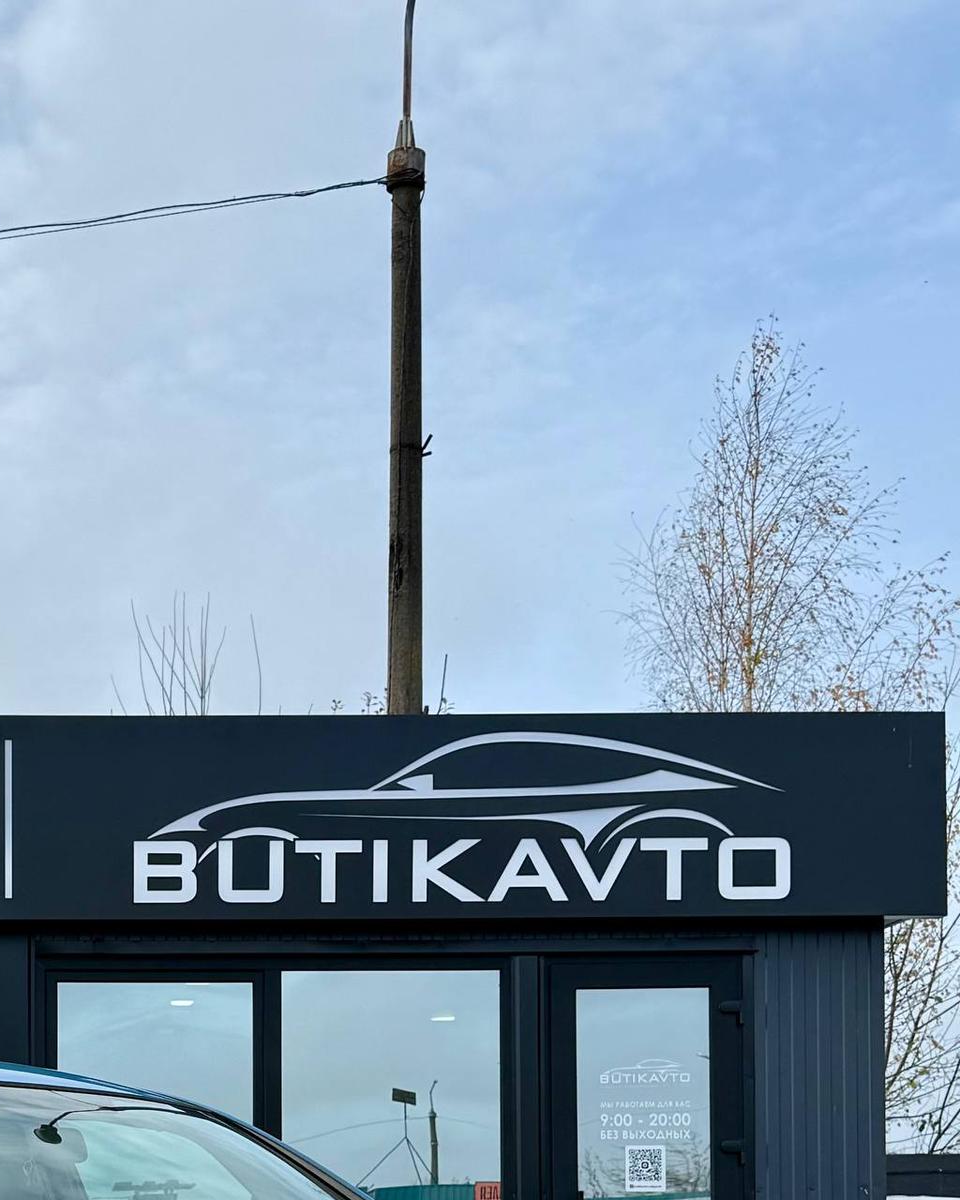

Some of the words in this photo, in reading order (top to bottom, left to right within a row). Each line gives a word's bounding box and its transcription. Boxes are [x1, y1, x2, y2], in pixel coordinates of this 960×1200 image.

[132, 836, 793, 905] BUTIKAVTO
[599, 1073, 691, 1084] BUTIKAVTO
[600, 1114, 632, 1126] 9:00
[649, 1113, 691, 1126] 20:00
[600, 1130, 618, 1139] БЕЗ
[622, 1130, 690, 1140] ВЫХОДНЫХ
